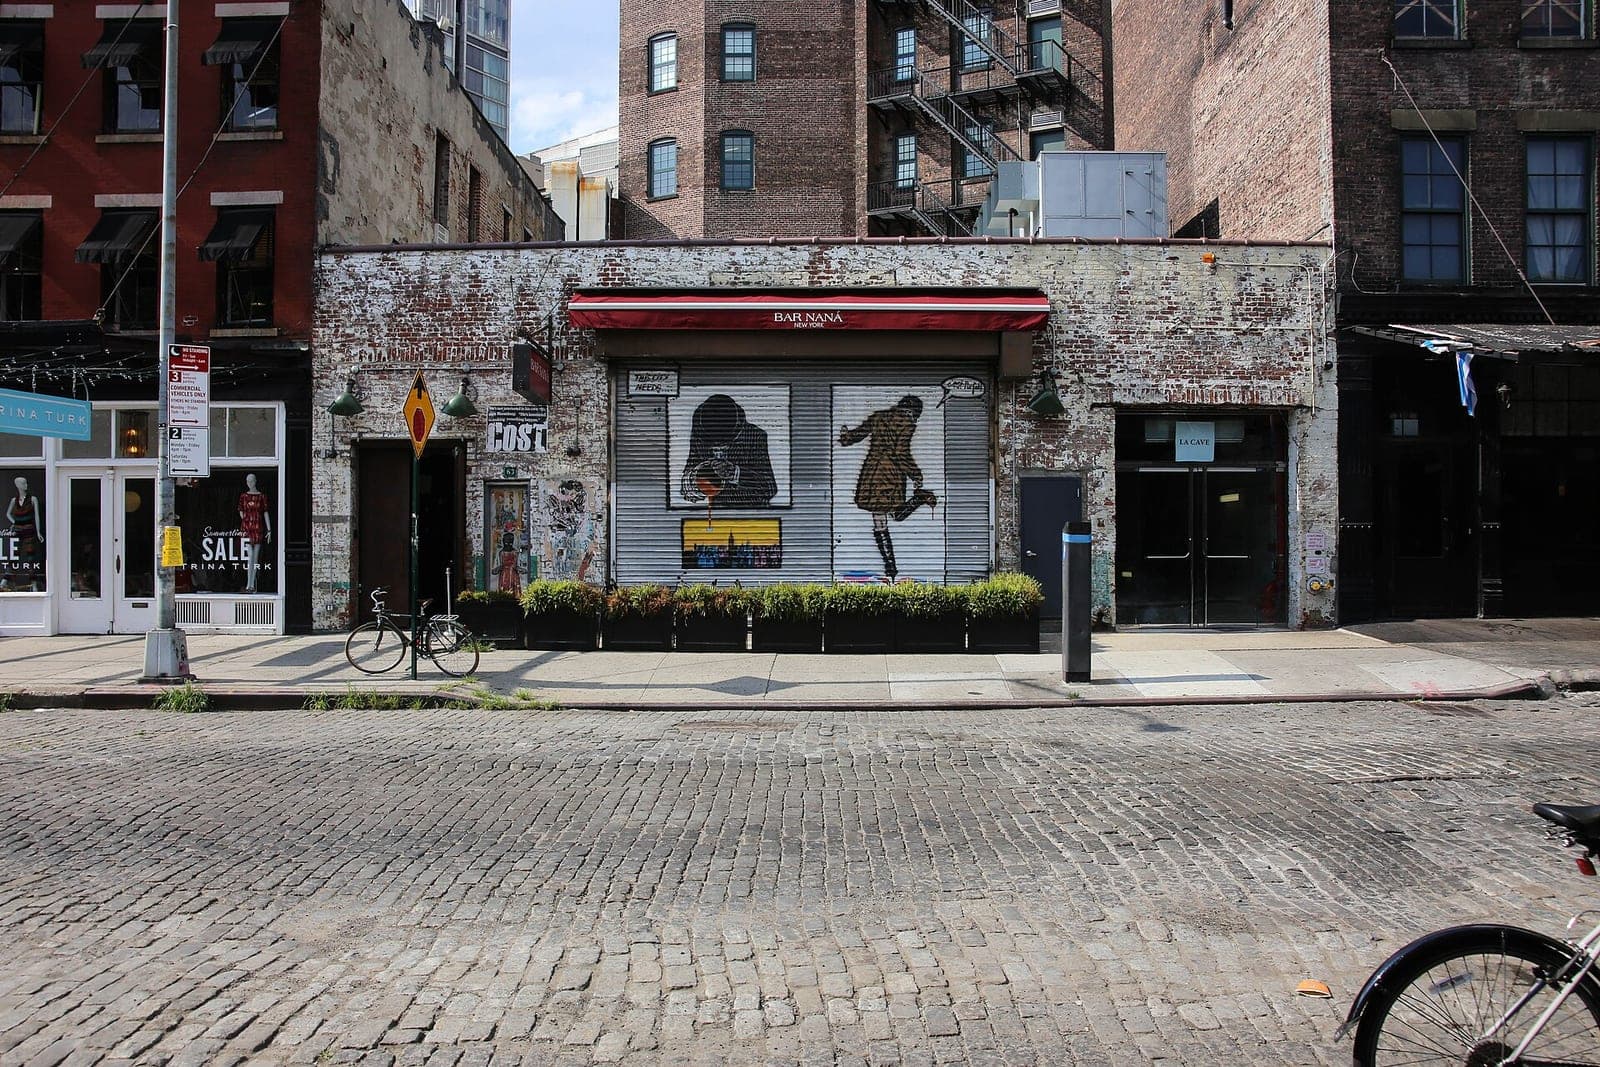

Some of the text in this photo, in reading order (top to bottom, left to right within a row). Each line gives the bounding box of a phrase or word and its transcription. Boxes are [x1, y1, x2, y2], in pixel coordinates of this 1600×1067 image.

[774, 310, 843, 322] BAR NANÁ
[172, 371, 179, 382] 3
[45, 410, 87, 426] TURK
[172, 428, 179, 439] 2
[484, 421, 548, 453] COST
[202, 526, 248, 538] Summertime
[202, 538, 250, 562] SALE
[1, 562, 40, 570] TURK
